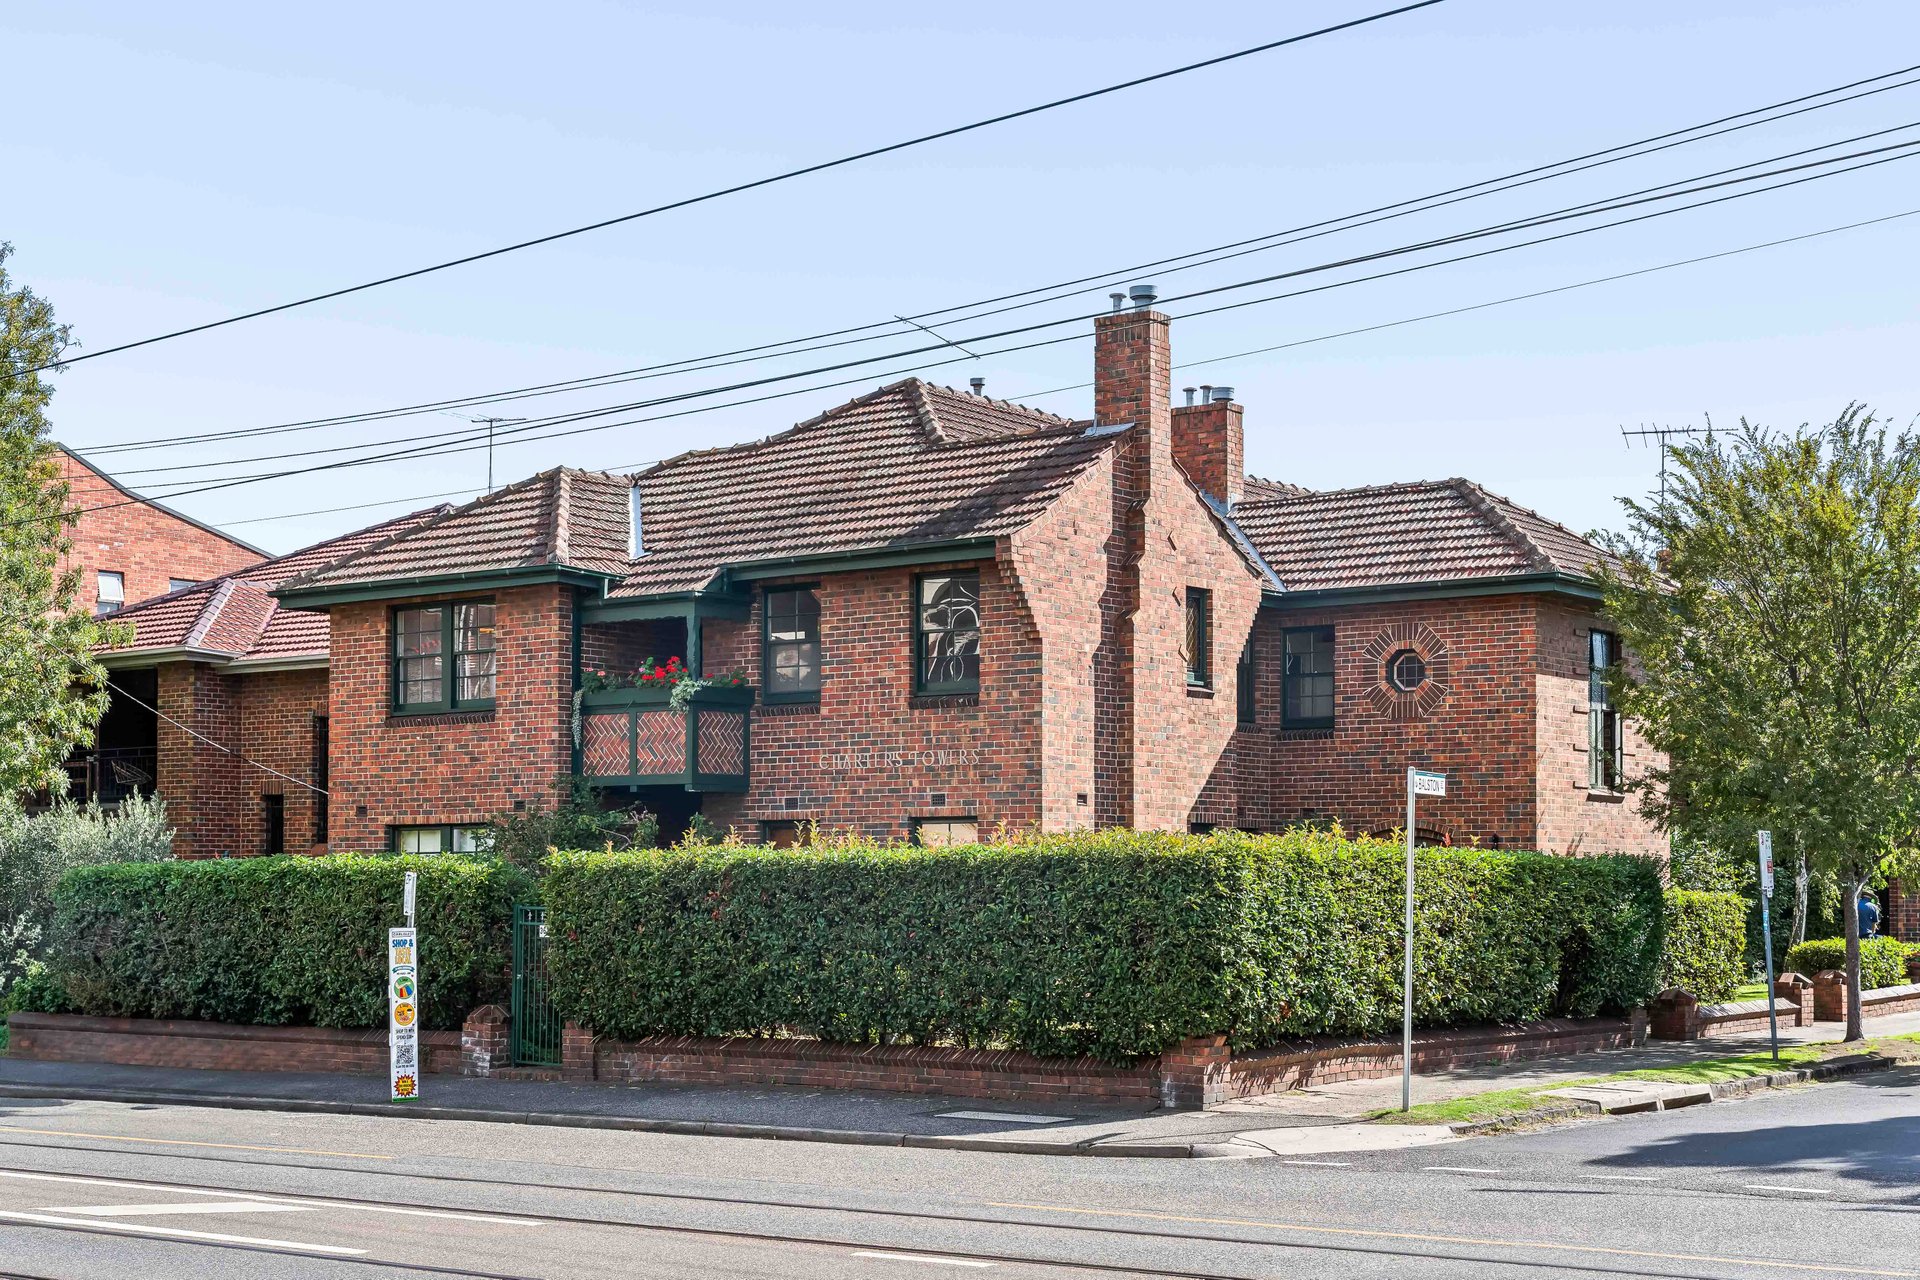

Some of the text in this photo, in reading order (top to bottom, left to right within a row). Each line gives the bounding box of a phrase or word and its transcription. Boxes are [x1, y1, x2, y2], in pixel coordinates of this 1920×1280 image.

[819, 749, 980, 769] CHARTERS TOWERS
[1418, 778, 1440, 791] BALSTON
[392, 939, 414, 948] SHOP &
